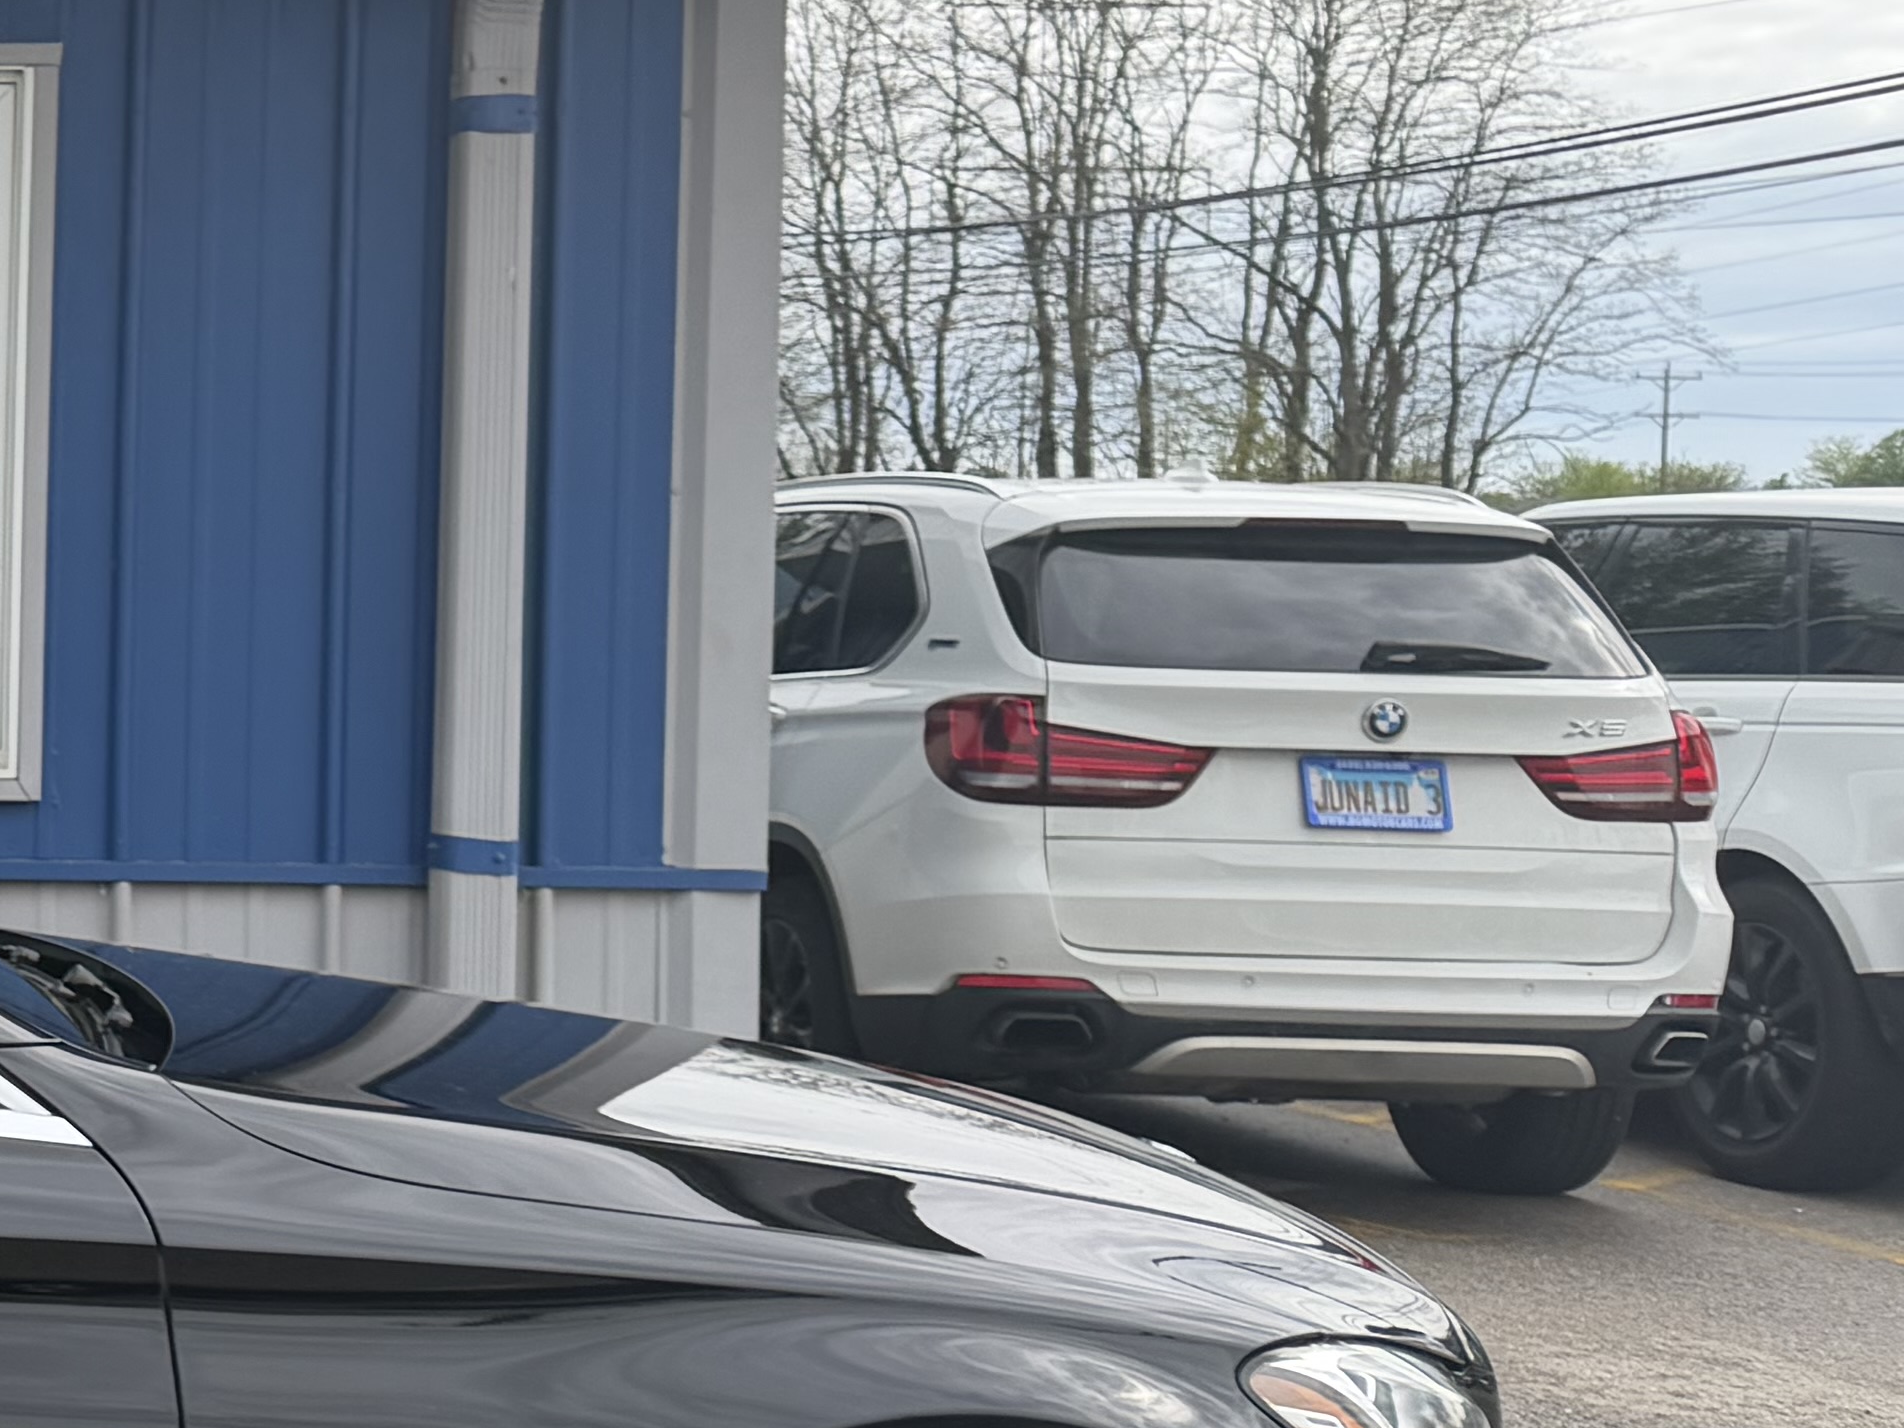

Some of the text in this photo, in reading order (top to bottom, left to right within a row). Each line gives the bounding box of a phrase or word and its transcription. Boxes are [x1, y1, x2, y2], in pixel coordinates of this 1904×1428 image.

[1561, 718, 1627, 739] X5
[1314, 778, 1442, 816] JUNAID 3
